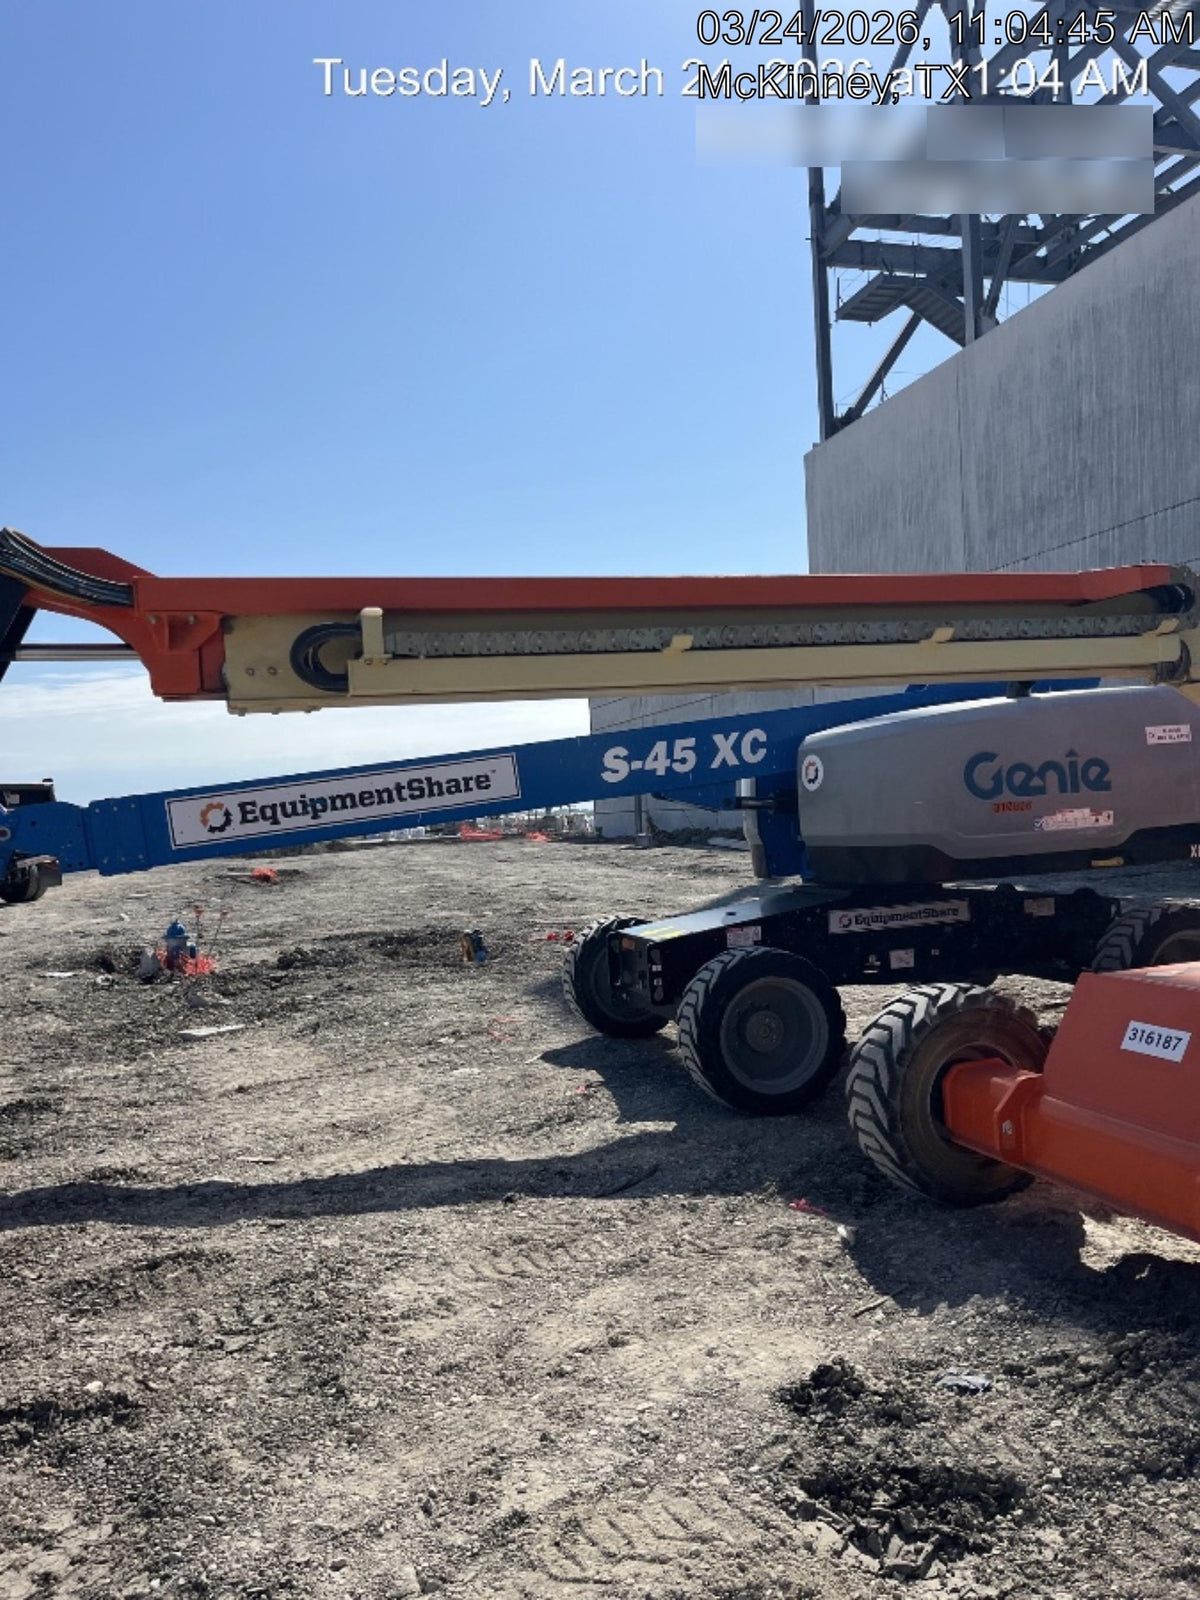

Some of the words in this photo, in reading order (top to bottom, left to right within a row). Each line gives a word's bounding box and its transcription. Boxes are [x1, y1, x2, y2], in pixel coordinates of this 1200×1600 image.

[600, 737, 698, 783] S-45
[710, 728, 768, 768] XC
[963, 749, 1112, 801] Genie
[239, 771, 492, 826] EquipmentShare
[1128, 1027, 1183, 1052] 316187
